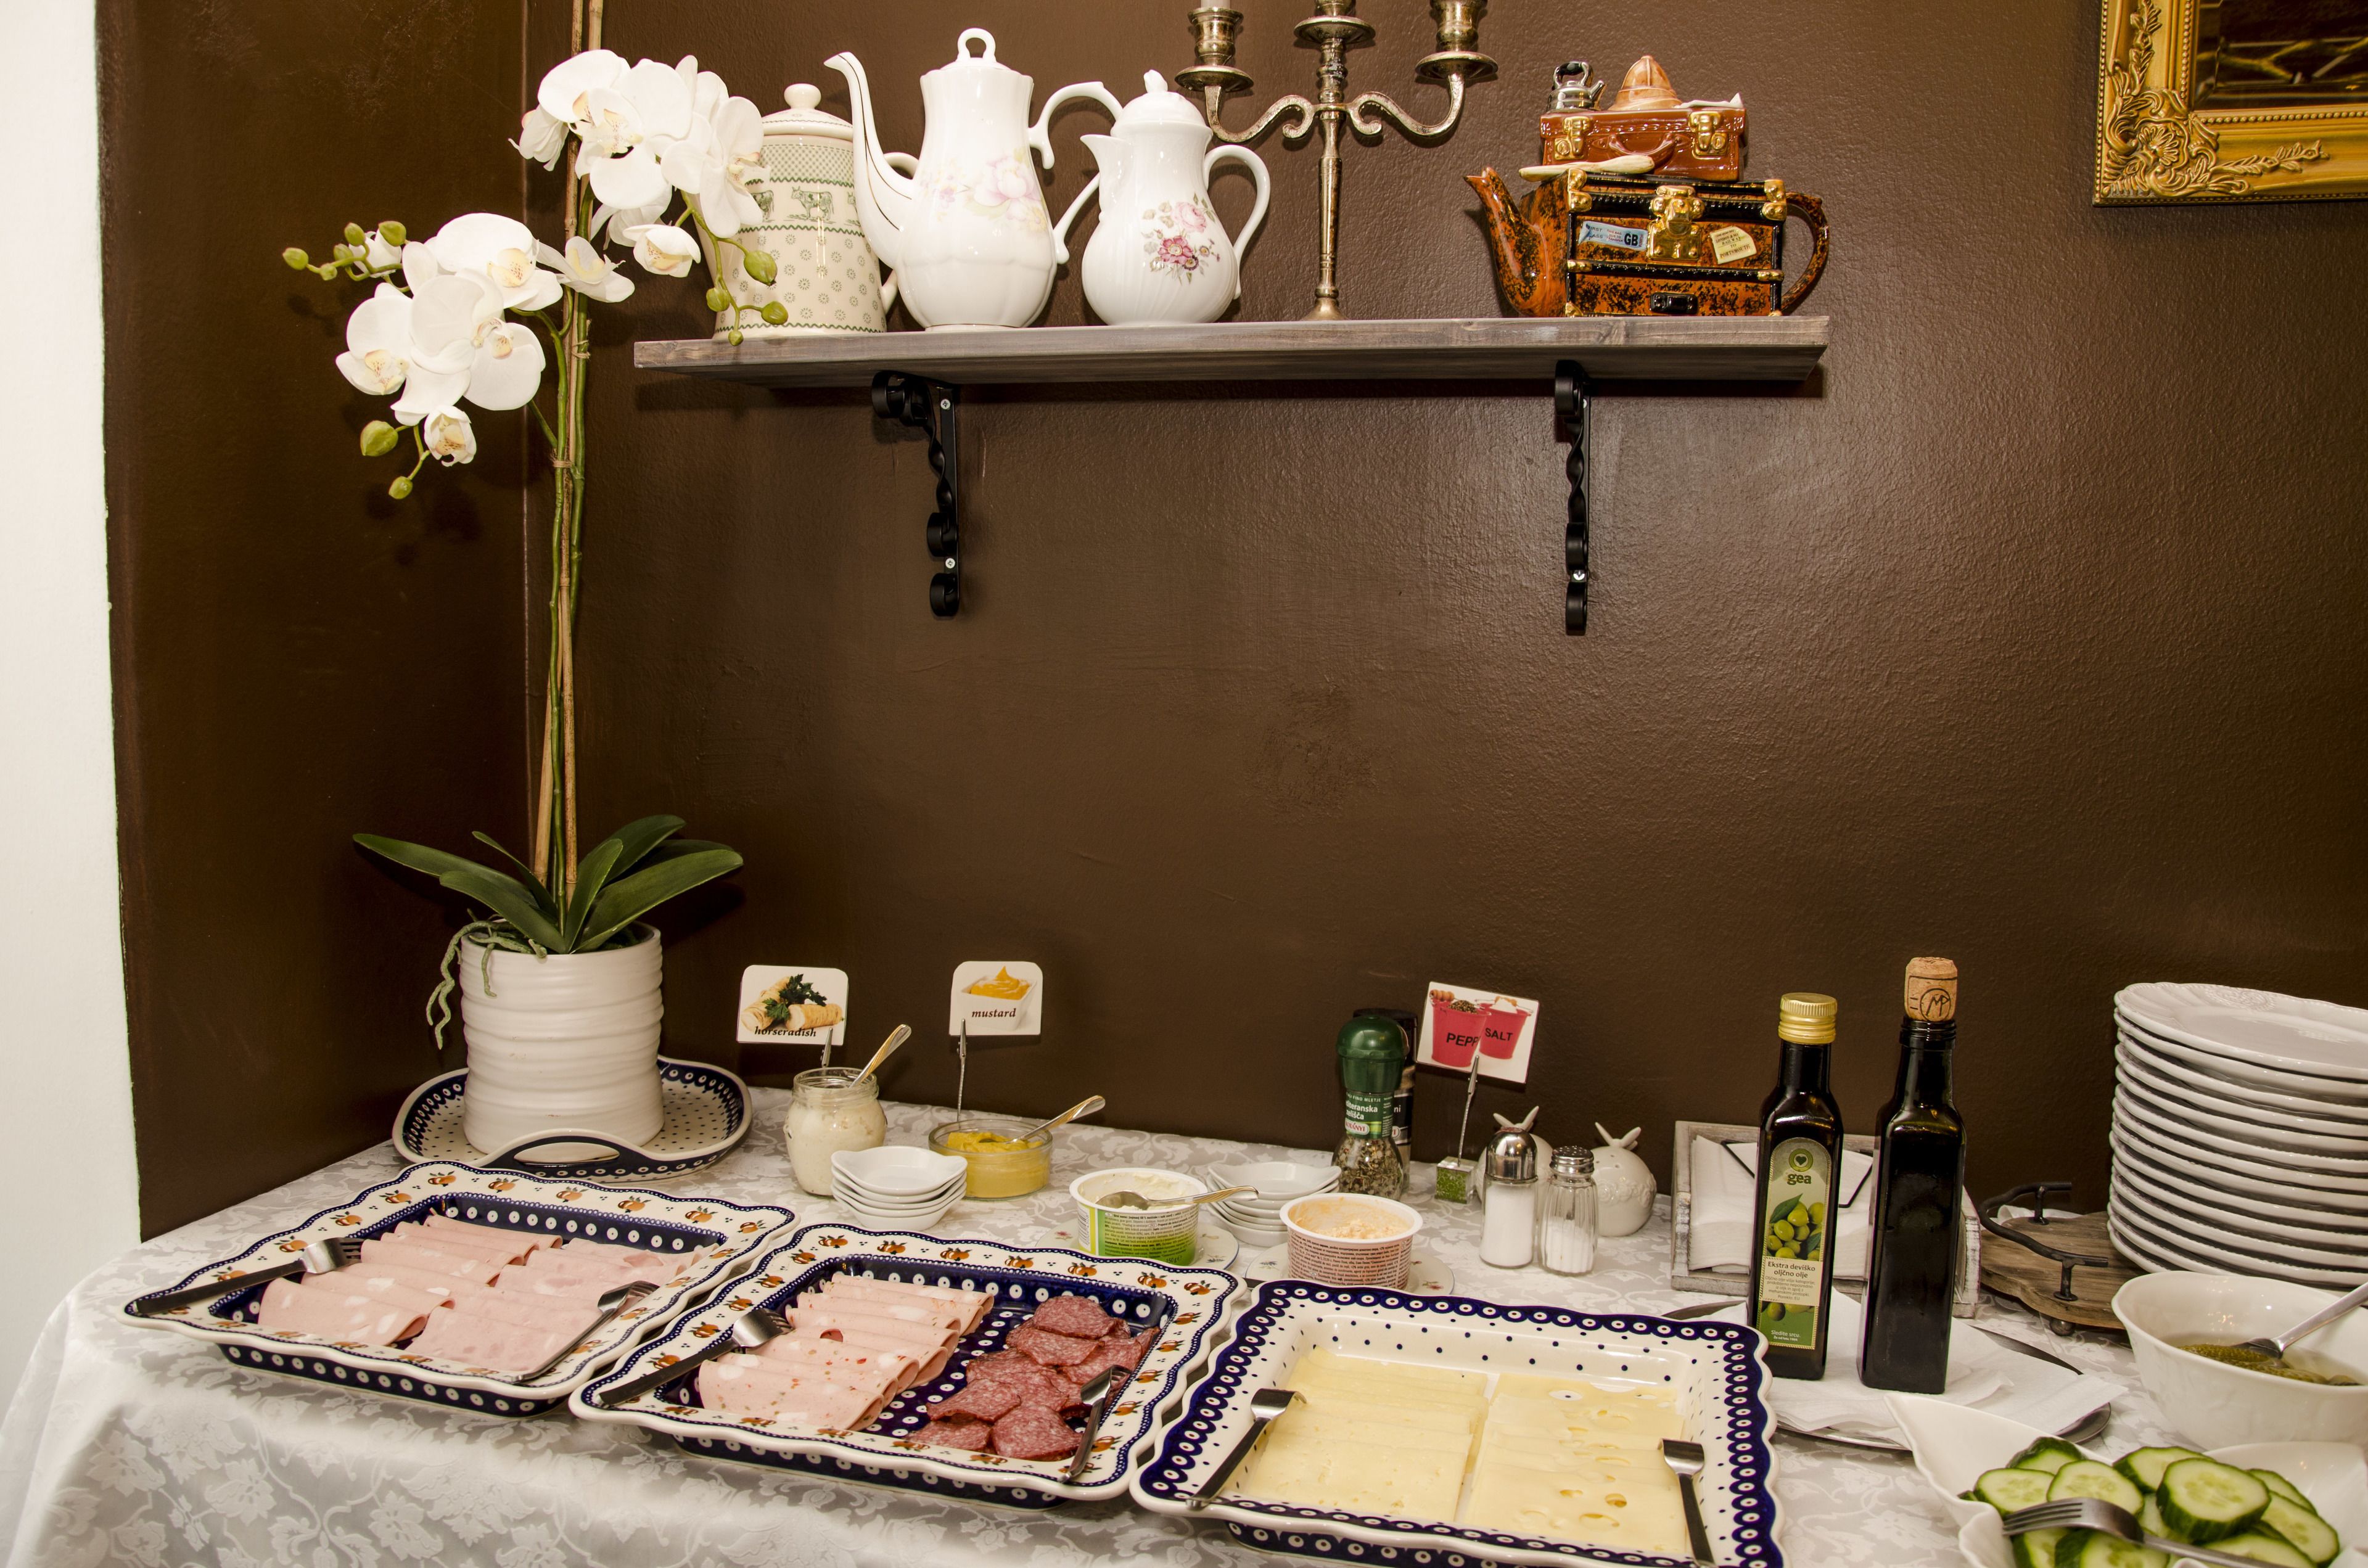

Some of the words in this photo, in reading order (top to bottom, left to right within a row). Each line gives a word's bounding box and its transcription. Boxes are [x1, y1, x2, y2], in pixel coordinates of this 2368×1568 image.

[1624, 233, 1638, 246] GB
[1719, 244, 1751, 258] PORTSMOUTH
[971, 1008, 1016, 1017] mustard
[754, 1025, 816, 1037] horseradish
[1484, 1027, 1513, 1041] SALT
[1786, 1173, 1812, 1185] gea
[1767, 1261, 1788, 1269] Ekstra
[1790, 1263, 1815, 1271] deviško
[1774, 1269, 1794, 1277] oljčno
